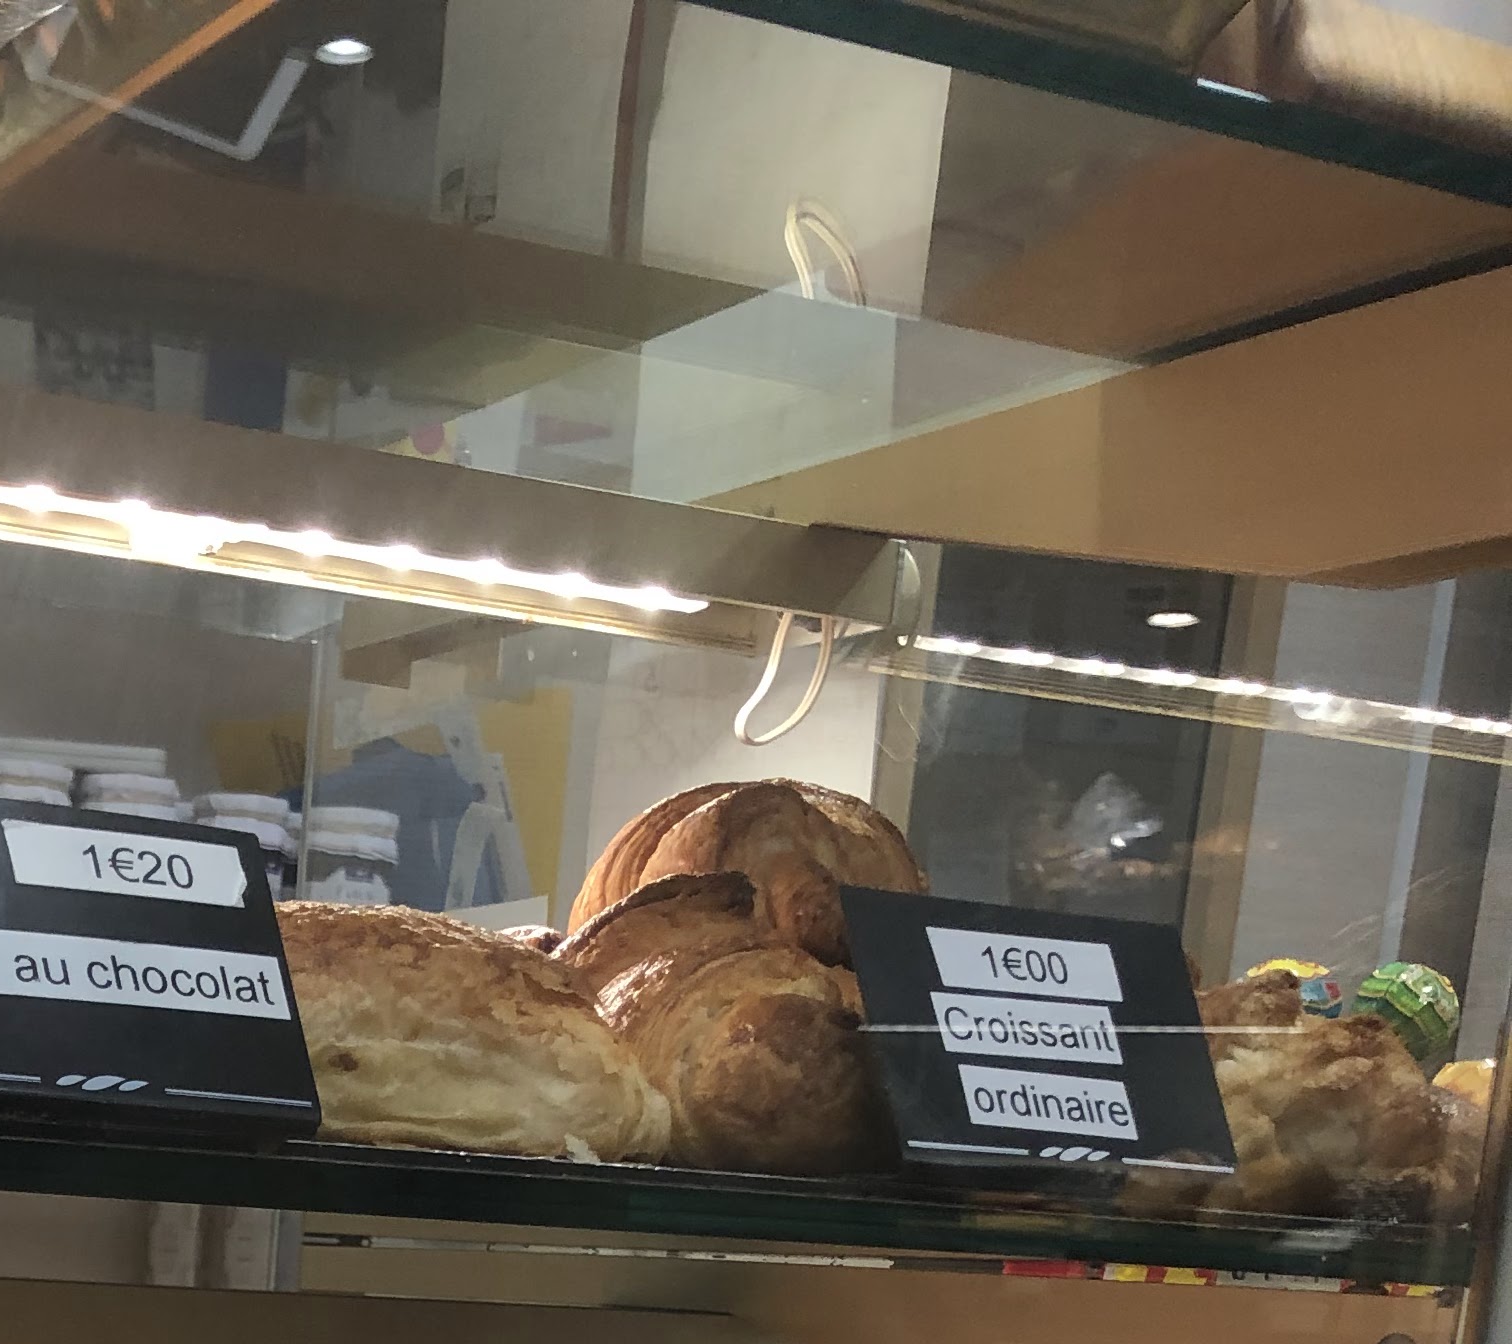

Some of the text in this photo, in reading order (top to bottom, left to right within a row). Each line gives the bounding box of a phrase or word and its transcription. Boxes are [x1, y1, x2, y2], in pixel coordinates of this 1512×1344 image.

[82, 843, 195, 891] 1€20
[13, 954, 71, 986] au
[88, 955, 274, 1006] chocolat
[981, 946, 1068, 987] 1€00
[944, 1006, 1116, 1055] Croissant
[973, 1084, 1131, 1128] ordinaire
